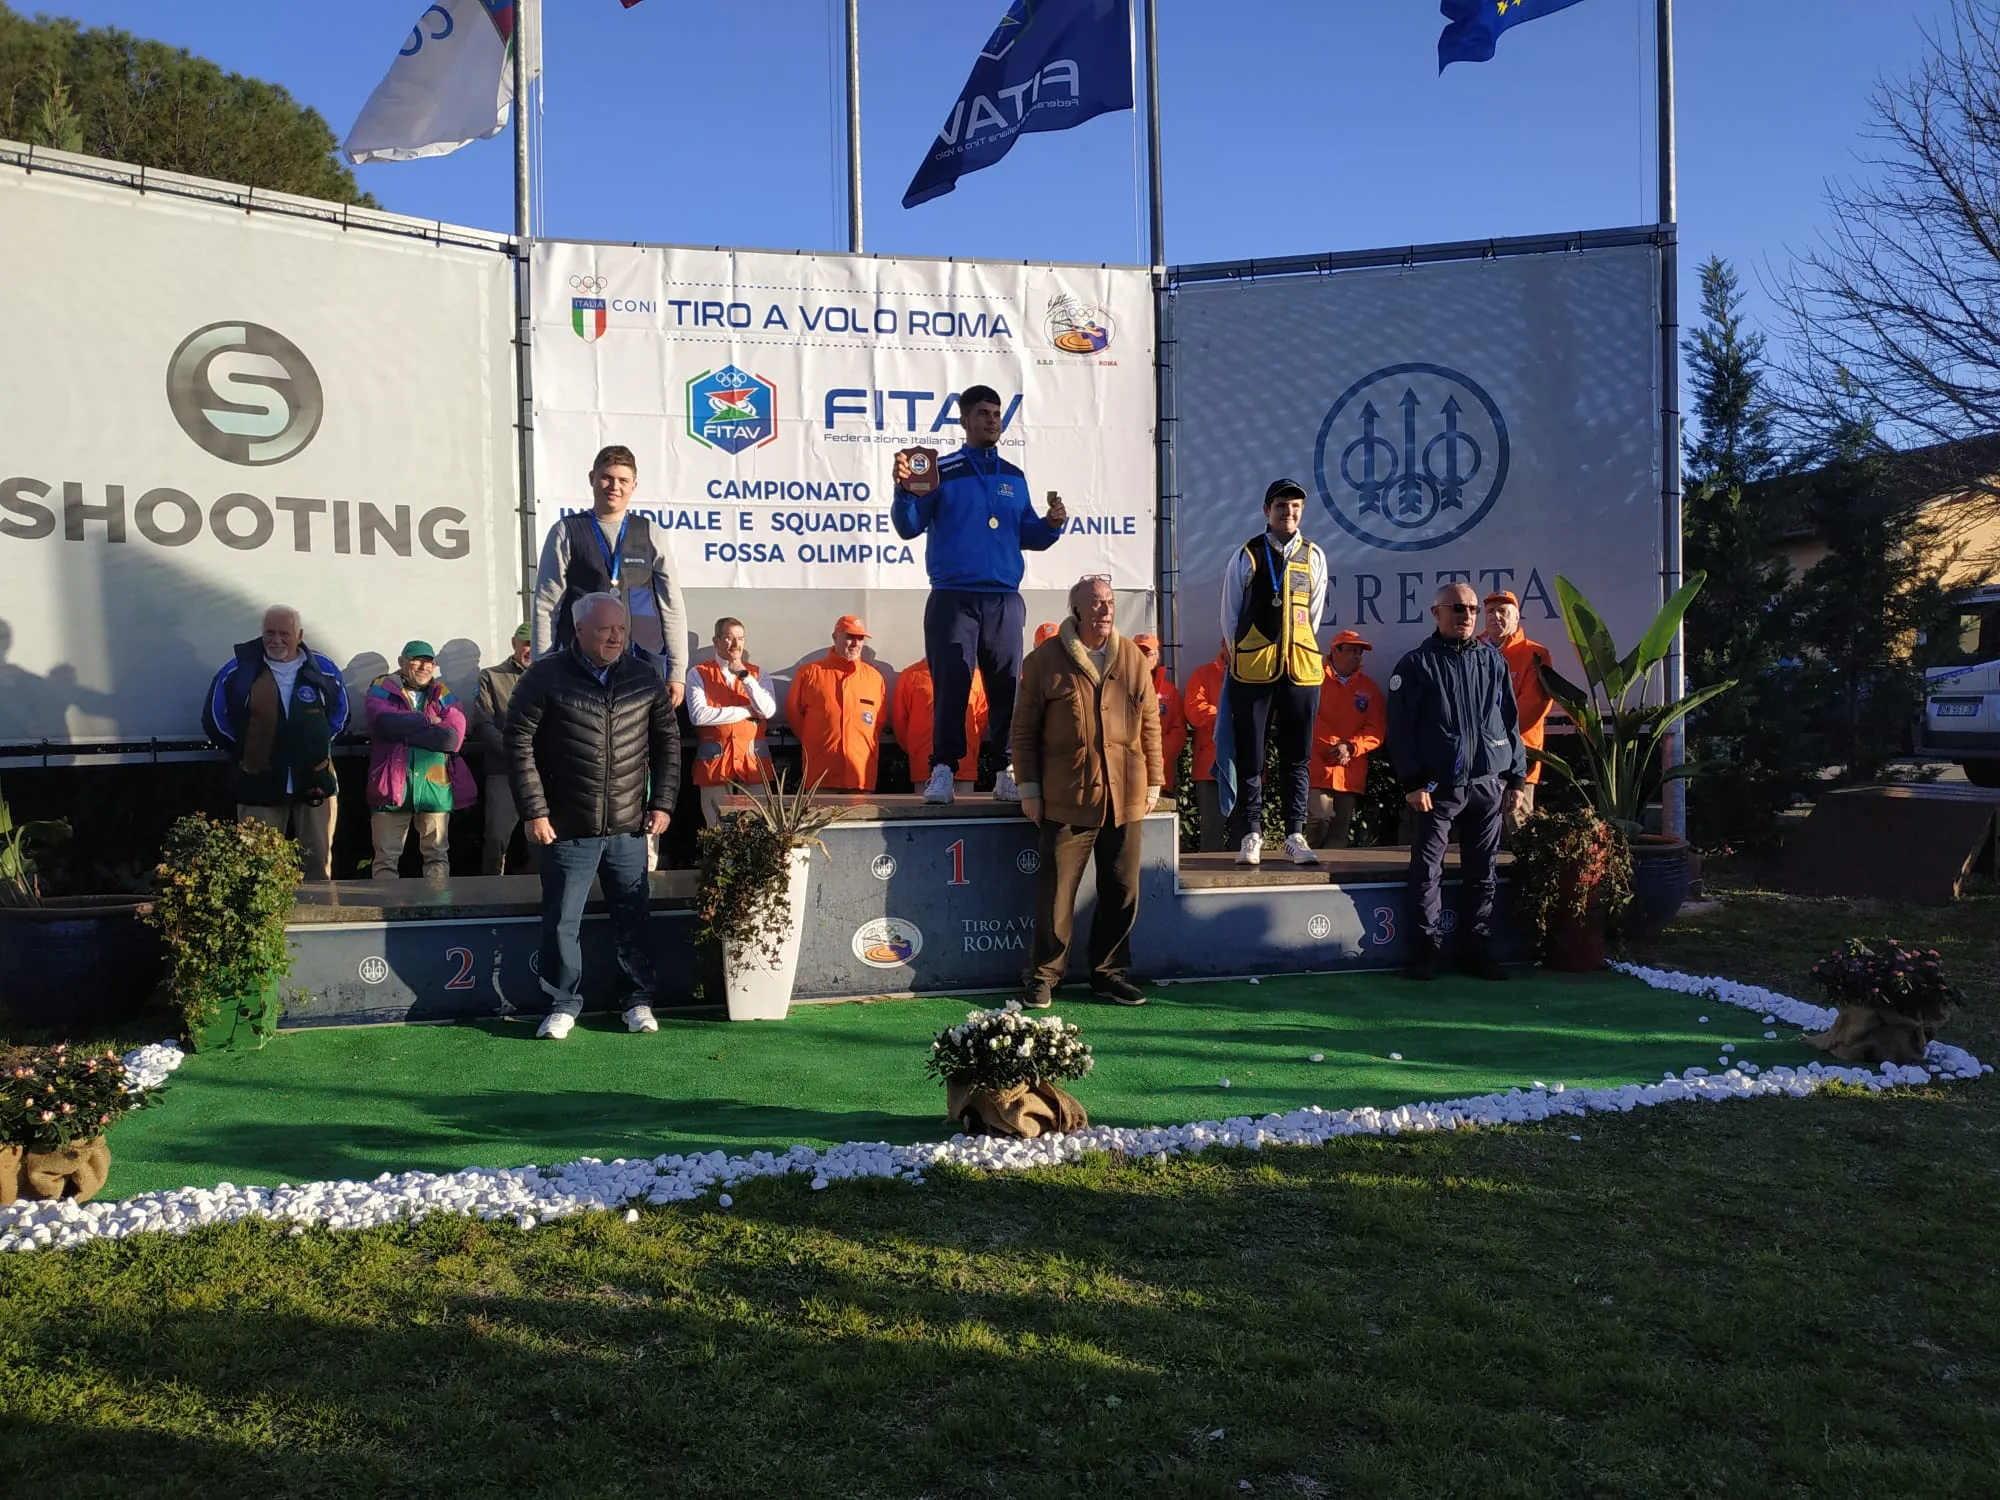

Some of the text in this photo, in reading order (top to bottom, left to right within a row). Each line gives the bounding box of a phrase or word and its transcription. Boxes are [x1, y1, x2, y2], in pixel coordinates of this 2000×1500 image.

[575, 299, 604, 308] ITALIA
[612, 299, 657, 313] CONI
[668, 300, 1013, 338] TIRO A VOLO ROMA
[703, 425, 761, 439] FITAV
[911, 436, 956, 446] Italiana
[998, 438, 1026, 447] Volo
[706, 479, 870, 501] CAMPIONATO
[0, 476, 470, 560] SHOOTING
[739, 511, 754, 531] E
[771, 512, 889, 536] SQUADRE
[704, 542, 915, 564] FOSSA OLIMPICA
[945, 838, 970, 885] 1
[961, 919, 1001, 933] TIRO
[1004, 919, 1016, 931] A
[1372, 906, 1396, 945] 3
[963, 934, 1025, 953] ROMA
[444, 946, 476, 990] 2
